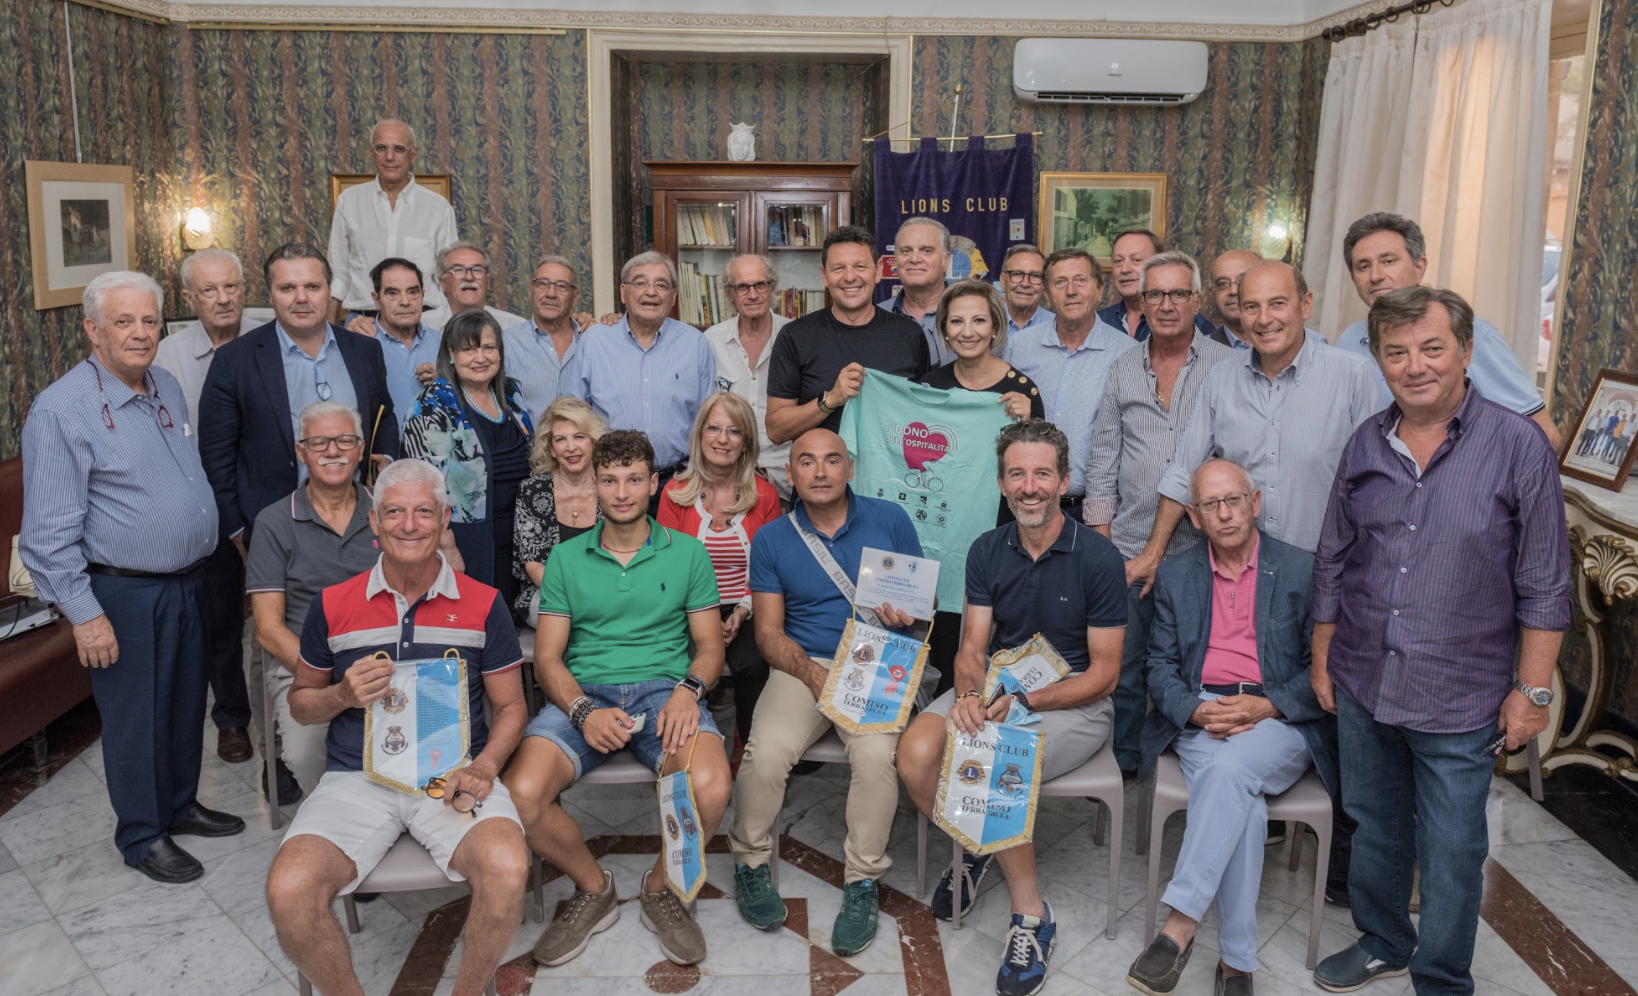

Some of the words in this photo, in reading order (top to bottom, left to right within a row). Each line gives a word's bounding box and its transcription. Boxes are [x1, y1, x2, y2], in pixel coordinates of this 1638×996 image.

[902, 199, 950, 214] LIONS
[966, 197, 1008, 212] CLUB
[895, 424, 929, 439] DONO
[801, 528, 829, 565] BASIL
[857, 628, 888, 643] LIONS
[889, 639, 916, 653] CLUB
[843, 700, 865, 710] TERRA
[866, 706, 886, 716] IBLEA
[844, 693, 889, 711] COMISO
[962, 738, 996, 751] LIONS
[998, 744, 1029, 757] CLUB
[961, 805, 986, 815] TERRA
[987, 810, 1010, 820] IBLEA
[962, 796, 1011, 813] COMISO
[672, 848, 693, 859] COMISO
